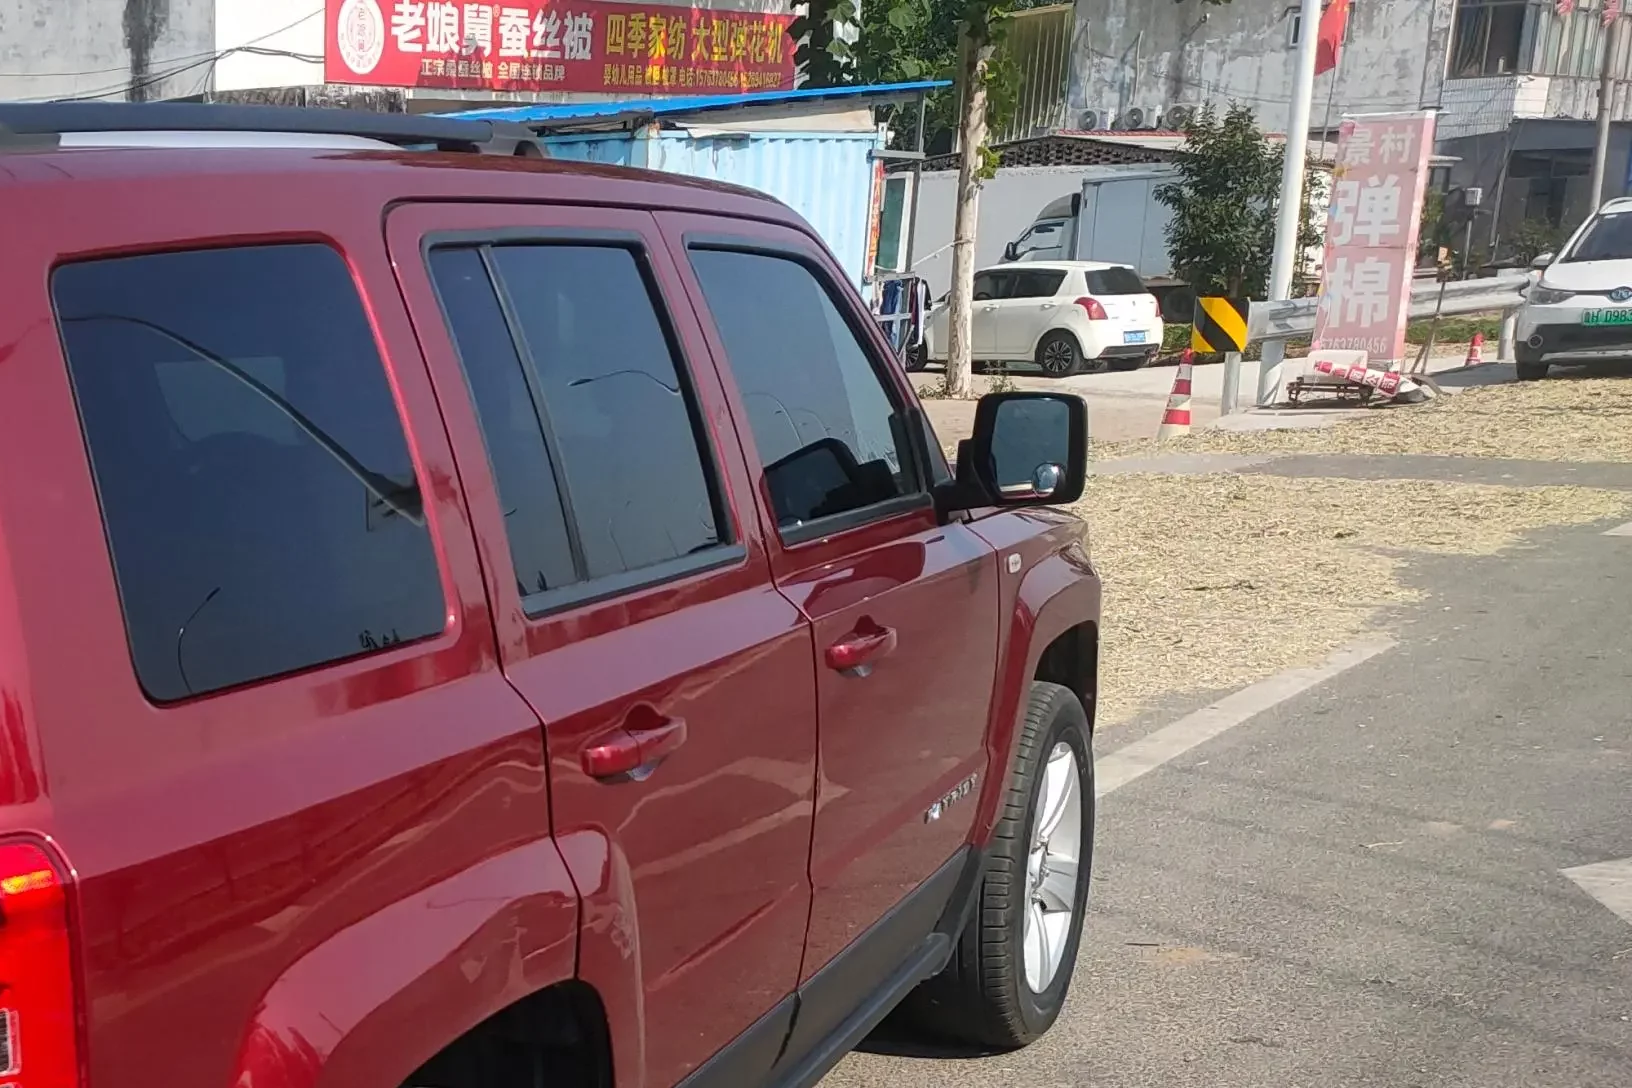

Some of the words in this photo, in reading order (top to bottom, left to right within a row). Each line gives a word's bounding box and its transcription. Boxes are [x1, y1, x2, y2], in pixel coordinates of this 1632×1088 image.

[606, 13, 686, 60] 四季家纺
[692, 16, 784, 64] 大型弹花机
